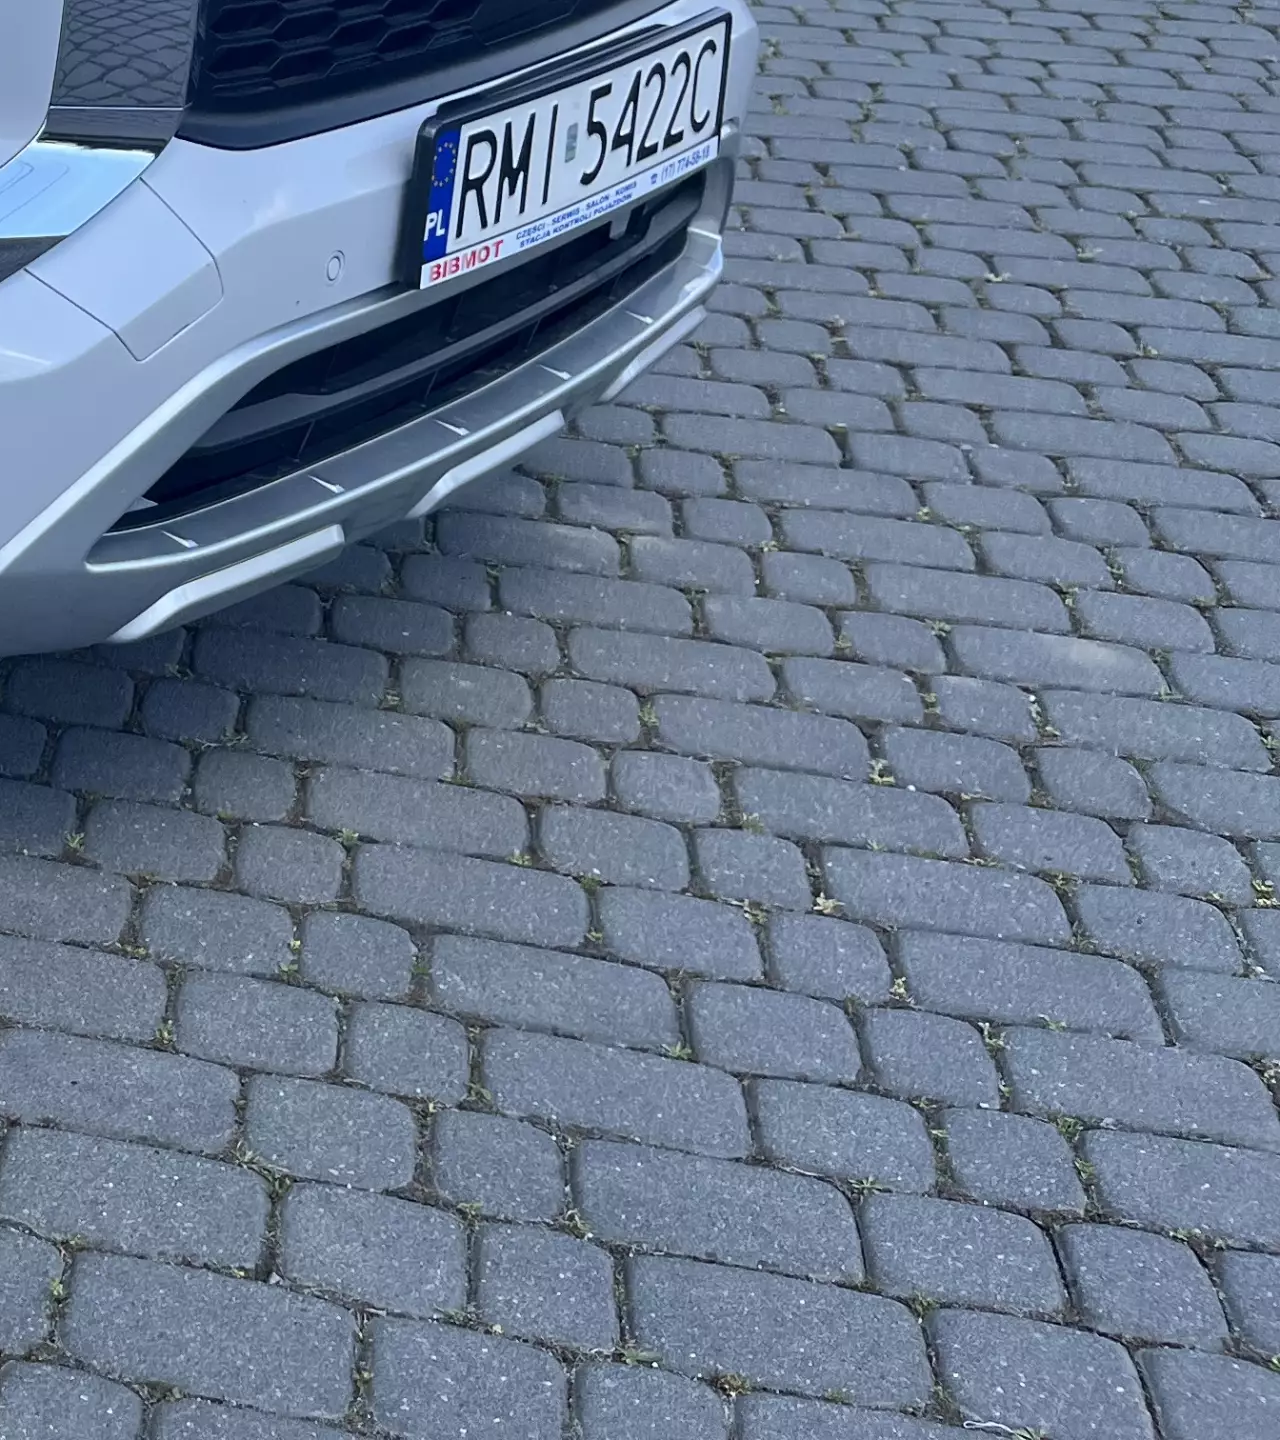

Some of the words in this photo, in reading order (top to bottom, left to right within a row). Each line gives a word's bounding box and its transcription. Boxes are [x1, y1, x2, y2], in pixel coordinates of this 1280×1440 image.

[455, 102, 559, 240] RMI
[579, 39, 717, 187] 5422C
[424, 209, 446, 242] PL
[429, 239, 505, 282] BIBMOT
